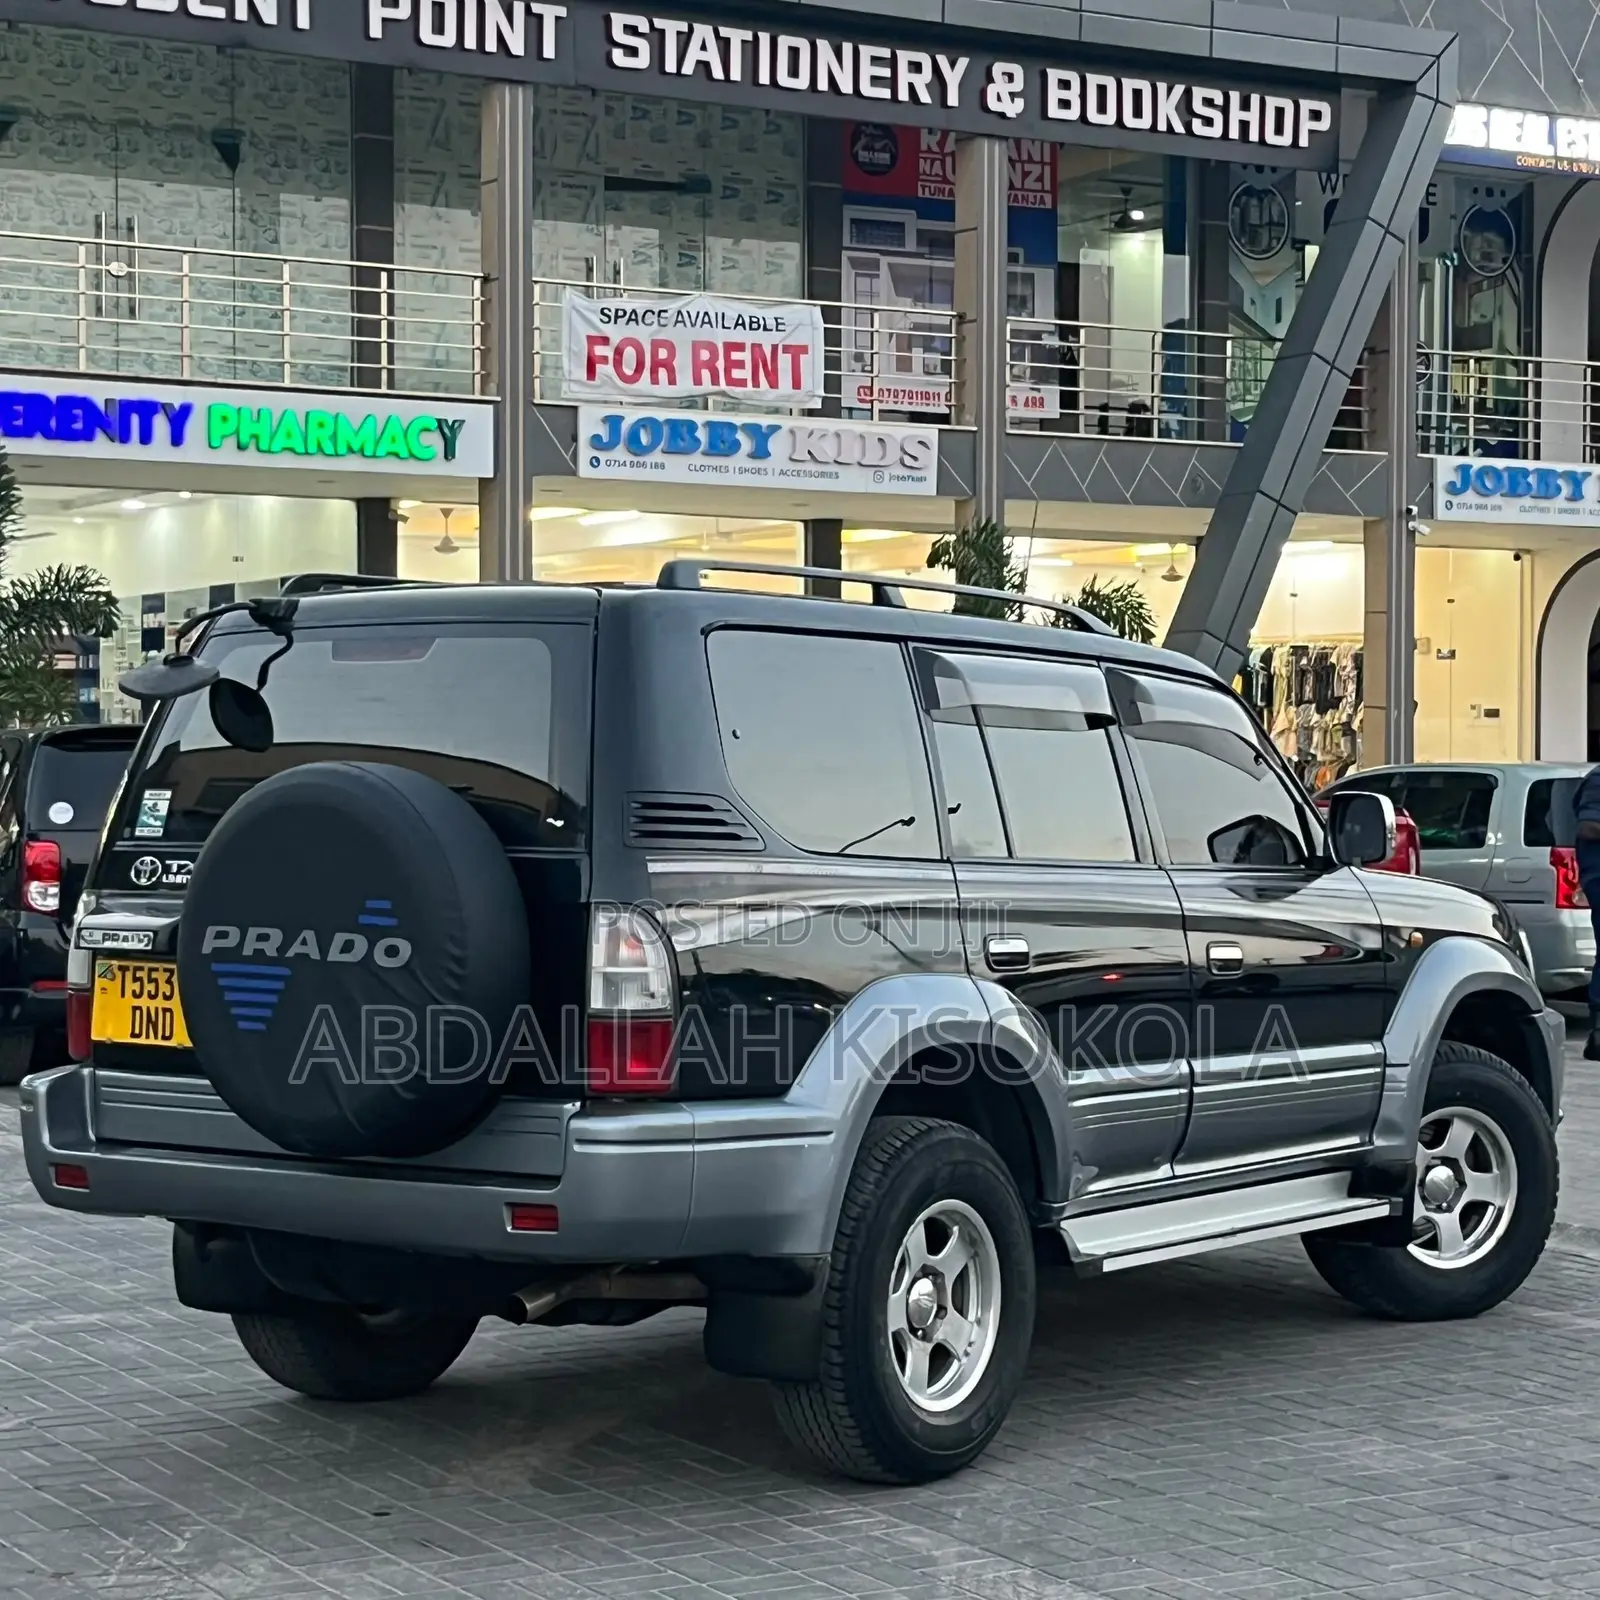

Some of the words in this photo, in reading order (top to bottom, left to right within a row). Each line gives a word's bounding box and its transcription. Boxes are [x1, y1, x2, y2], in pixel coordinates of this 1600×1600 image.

[368, 0, 568, 60] POINT
[609, 12, 970, 107] STATIONERY
[986, 61, 1025, 118] &
[1046, 68, 1331, 148] BOOKSHOP
[599, 306, 669, 329] SPACE
[673, 309, 787, 333] AVAILABLE
[585, 334, 678, 387] FOR
[691, 340, 809, 391] RENT
[0, 391, 193, 447] ERENITY
[208, 402, 466, 462] PHARMACY
[589, 414, 783, 460] JOBBY
[788, 426, 933, 470] KIDS
[687, 463, 730, 474] CLOTHES
[738, 466, 769, 477] SHOES
[778, 468, 841, 480] ACCESSORIES
[1446, 463, 1593, 502] JOBBY
[202, 925, 412, 968] PRADO
[118, 965, 177, 1001] T553
[130, 1006, 175, 1041] DND
